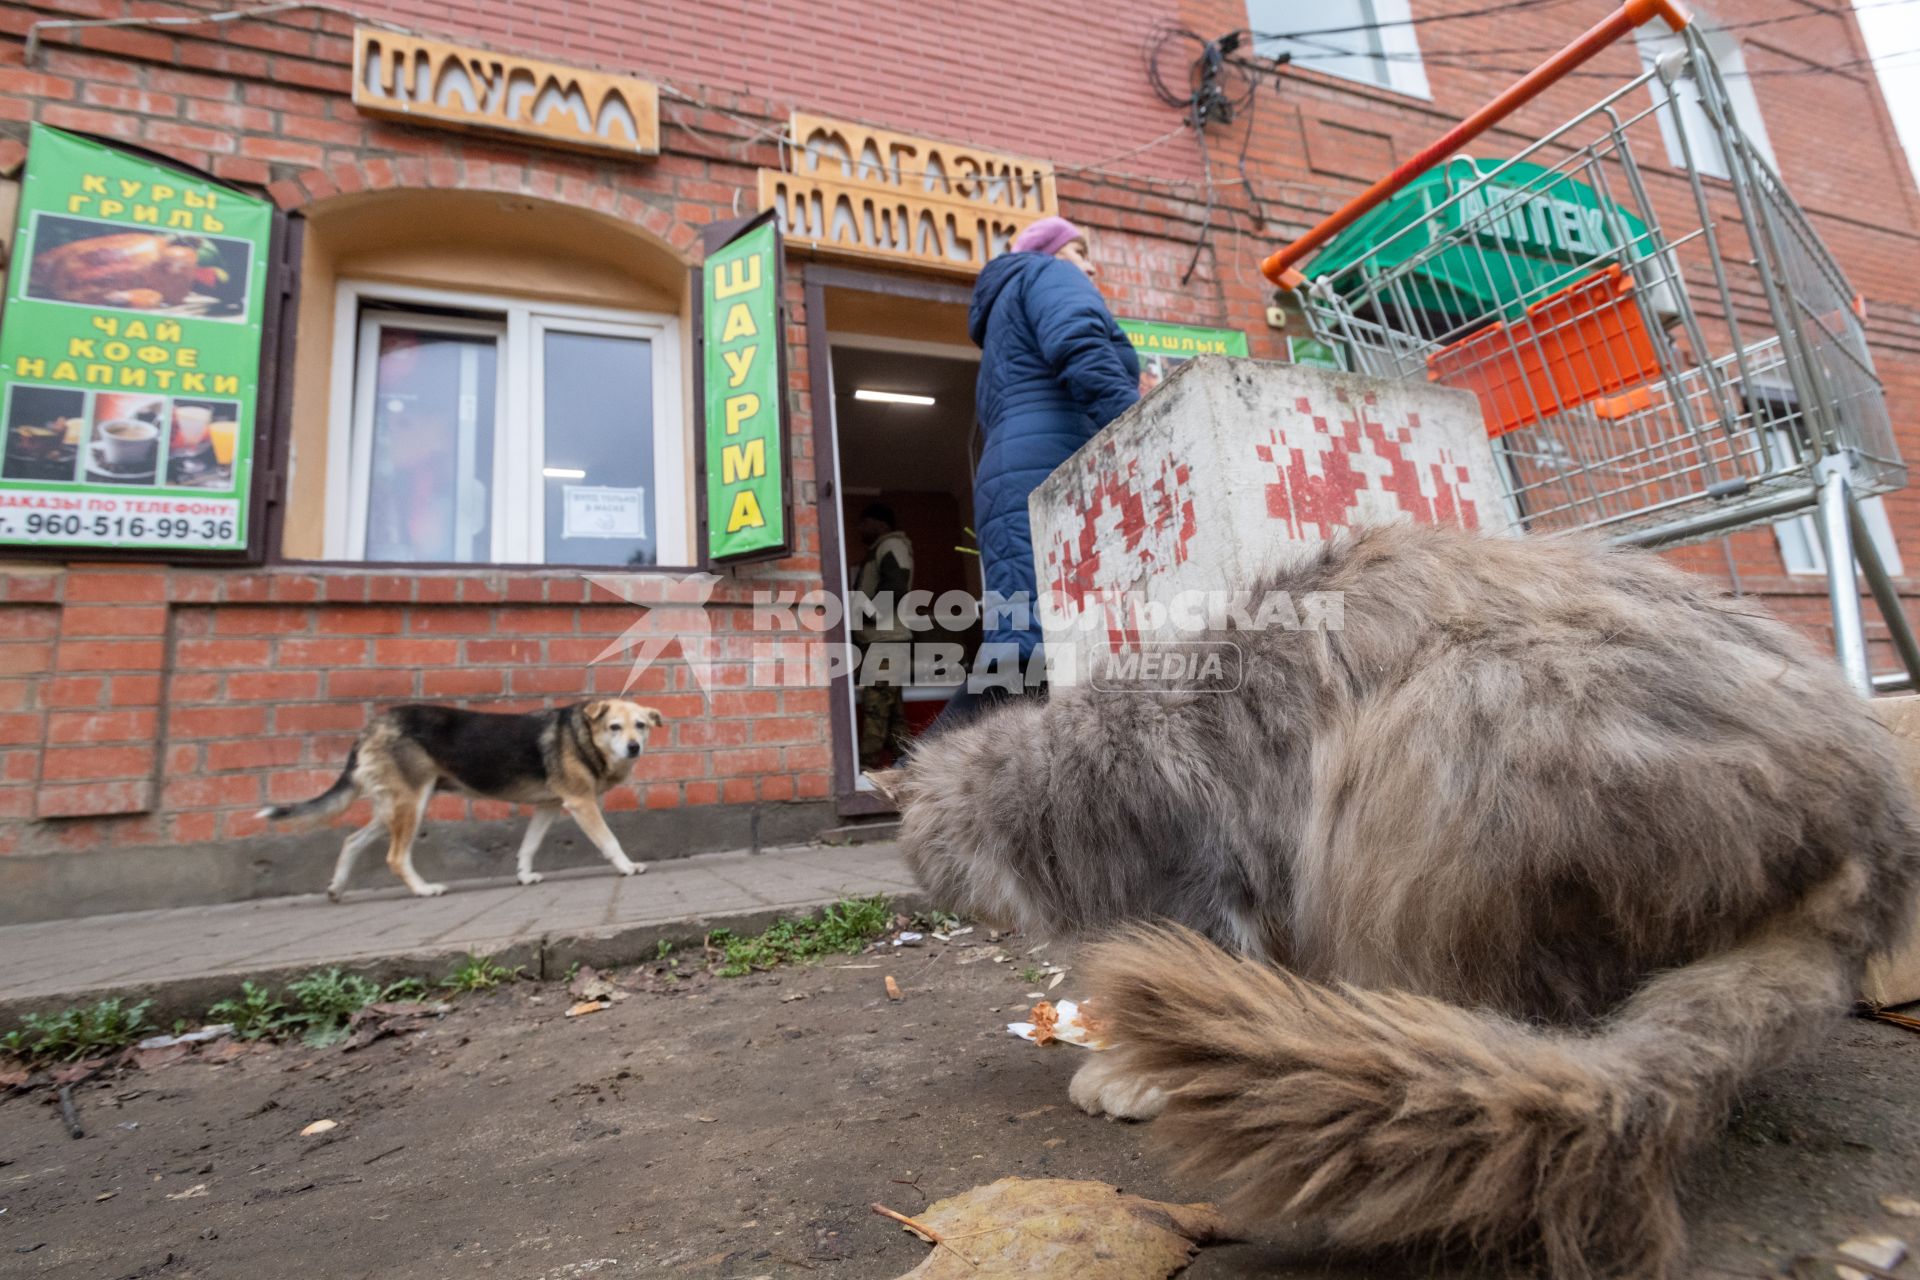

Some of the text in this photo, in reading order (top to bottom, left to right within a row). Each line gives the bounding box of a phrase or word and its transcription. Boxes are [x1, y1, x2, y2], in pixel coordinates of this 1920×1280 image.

[364, 38, 638, 143] ШАУРМА
[805, 127, 1044, 212] МАГАЗИН
[82, 174, 217, 210] КУРЫ
[67, 194, 225, 233] ГРИЛЬ
[92, 316, 182, 343] ЧАЙ
[1128, 331, 1226, 353] ШАШЛЫК
[69, 337, 198, 368] КОФЕ
[16, 357, 239, 395] НАПИТКИ
[713, 254, 766, 534] ШАУРМА
[88, 499, 116, 512] ПО
[26, 513, 232, 540] 960-516-99-36
